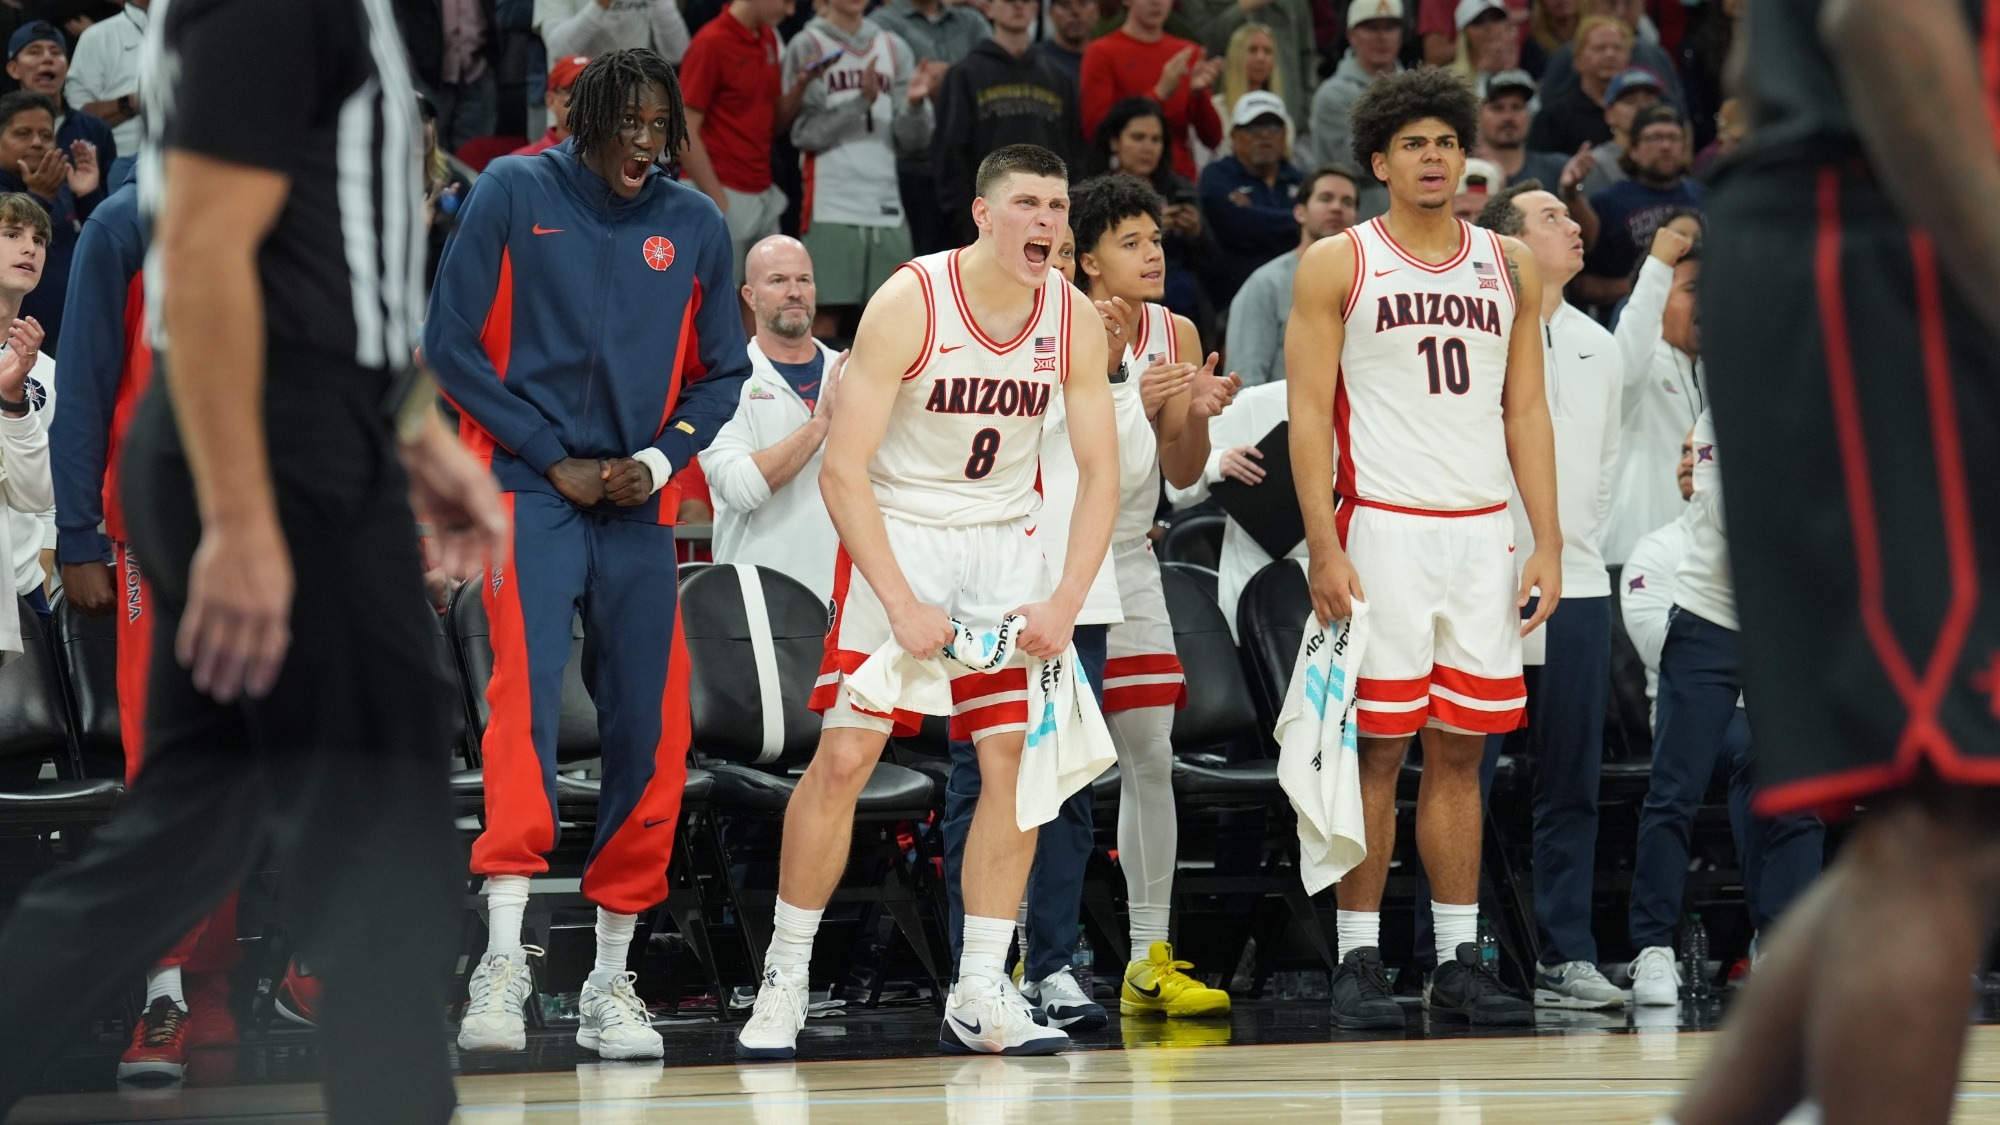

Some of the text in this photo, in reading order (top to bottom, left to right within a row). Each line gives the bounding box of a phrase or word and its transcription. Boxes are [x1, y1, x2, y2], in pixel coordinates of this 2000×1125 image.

[1375, 292, 1502, 338] ARIZONA
[1417, 336, 1470, 395] 10
[925, 376, 1051, 417] ARIZONA
[964, 427, 1001, 480] 8
